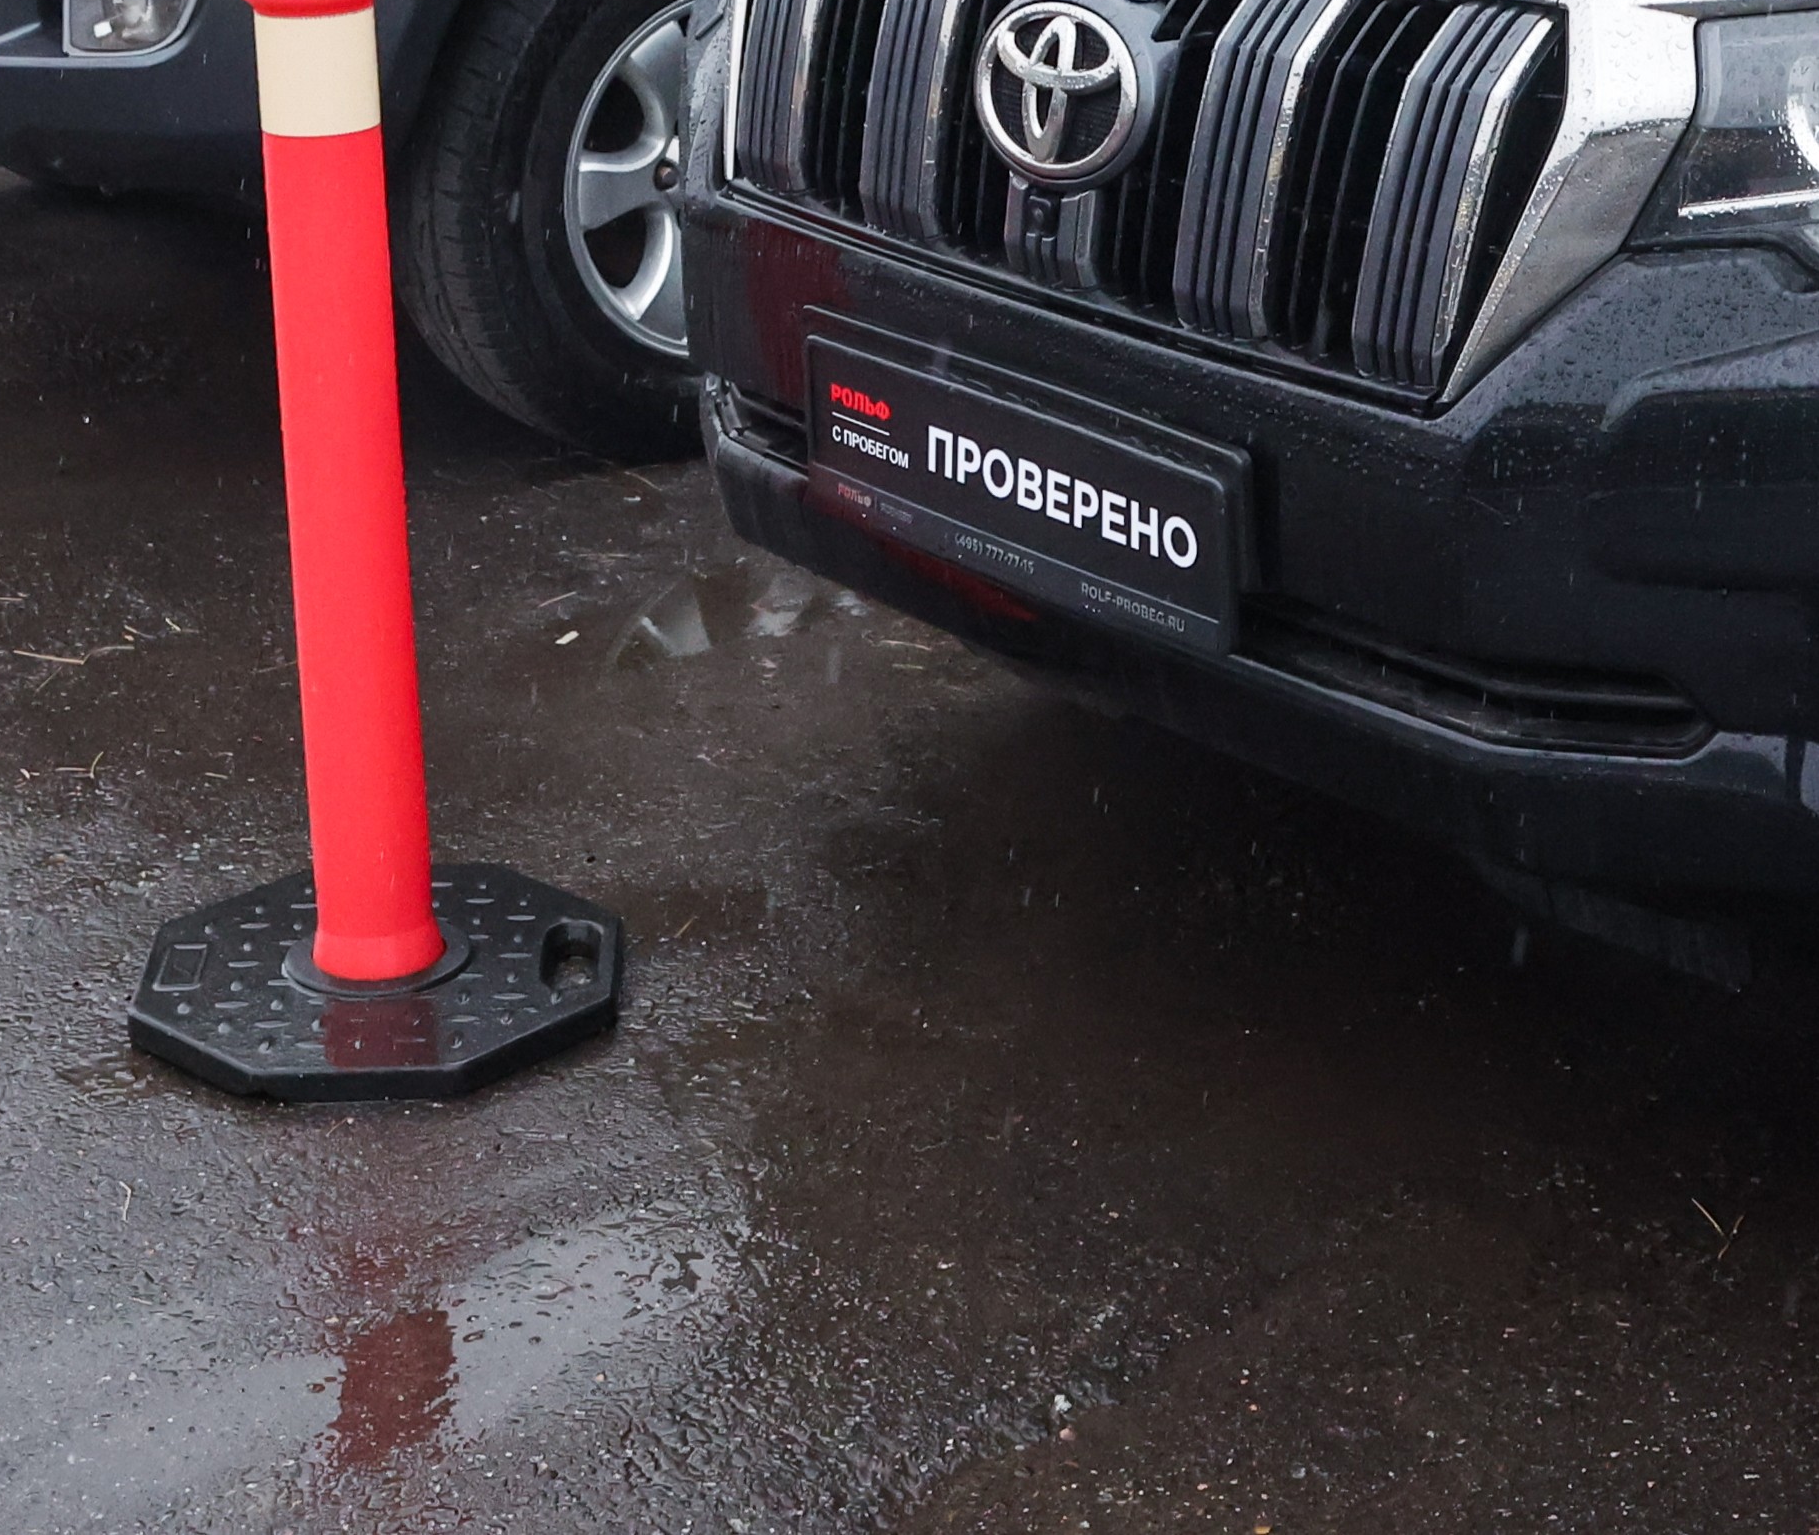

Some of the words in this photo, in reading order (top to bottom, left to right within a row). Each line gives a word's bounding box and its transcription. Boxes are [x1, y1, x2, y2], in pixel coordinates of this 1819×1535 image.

[830, 383, 892, 421] РОЛЬФ
[832, 425, 842, 443] С
[843, 429, 910, 470] ПРОБЕГОМ
[927, 424, 1199, 570] ПРОВЕРЕНО
